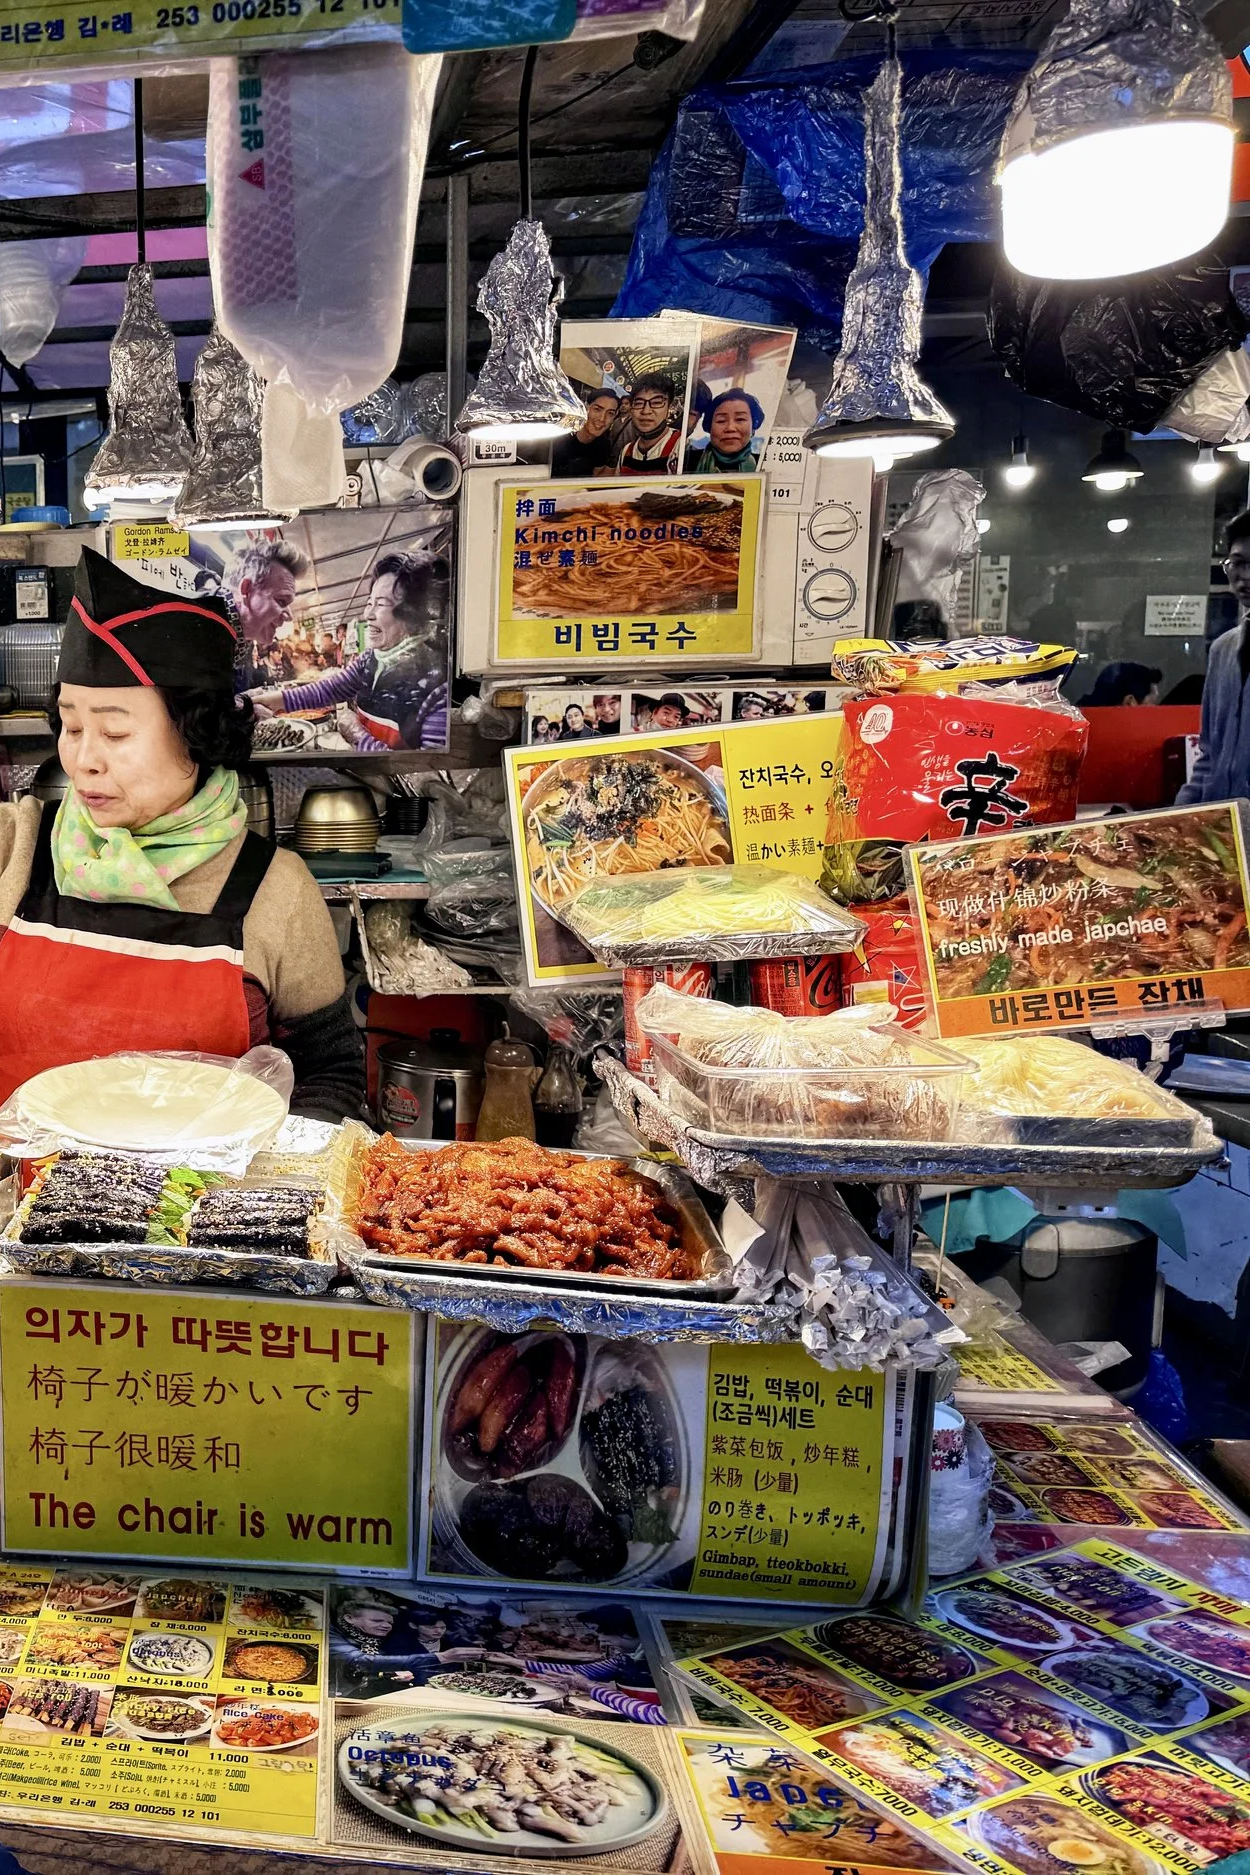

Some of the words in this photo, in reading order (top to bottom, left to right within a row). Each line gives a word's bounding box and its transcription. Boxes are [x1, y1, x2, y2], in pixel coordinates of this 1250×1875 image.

[156, 6, 199, 28] 253
[212, 0, 299, 23] 000255
[485, 443, 506, 454] 30m
[771, 488, 790, 498] 101
[124, 528, 151, 536] Gordon
[515, 526, 597, 545] Kimchi
[611, 524, 703, 541] noodles
[555, 621, 697, 653] 비빔국수
[964, 725, 994, 739] 농심
[940, 752, 1030, 836] 辛
[937, 877, 1117, 920] 现做什锦炒粉条
[939, 933, 1010, 959] freshly
[1018, 926, 1073, 949] made
[1084, 915, 1168, 945] japchae
[990, 986, 1119, 1026] 바로만든
[1138, 976, 1206, 1013] 잡채
[25, 1306, 148, 1348] 의자가
[172, 1316, 390, 1366] 따뜻합니다
[27, 1363, 373, 1416] 椅子が暖かいです
[713, 1373, 754, 1401] 김밥,
[765, 1377, 825, 1408] 떡볶이,
[836, 1384, 873, 1409] 순대
[712, 1400, 816, 1430] (조금씩)세트
[28, 1426, 240, 1473] 椅子很暖和
[29, 1492, 96, 1530] The
[118, 1498, 219, 1536] chair
[239, 1502, 265, 1539] is
[287, 1512, 393, 1546] warm
[702, 1550, 759, 1569] Gimbap,
[766, 1558, 850, 1577] tteokbokki,
[698, 1568, 793, 1585] sundae(small
[798, 1576, 858, 1591] amount)
[223, 1708, 249, 1718] Rice
[254, 1712, 284, 1721] Cake
[61, 1737, 86, 1748] 김밥
[105, 1743, 131, 1753] 순대
[348, 1745, 452, 1770] Octopus
[17, 1792, 63, 1804] 우리은행
[108, 1801, 130, 1811] 253
[134, 1804, 176, 1816] 000255
[182, 1809, 195, 1818] 12
[201, 1811, 220, 1821] 101
